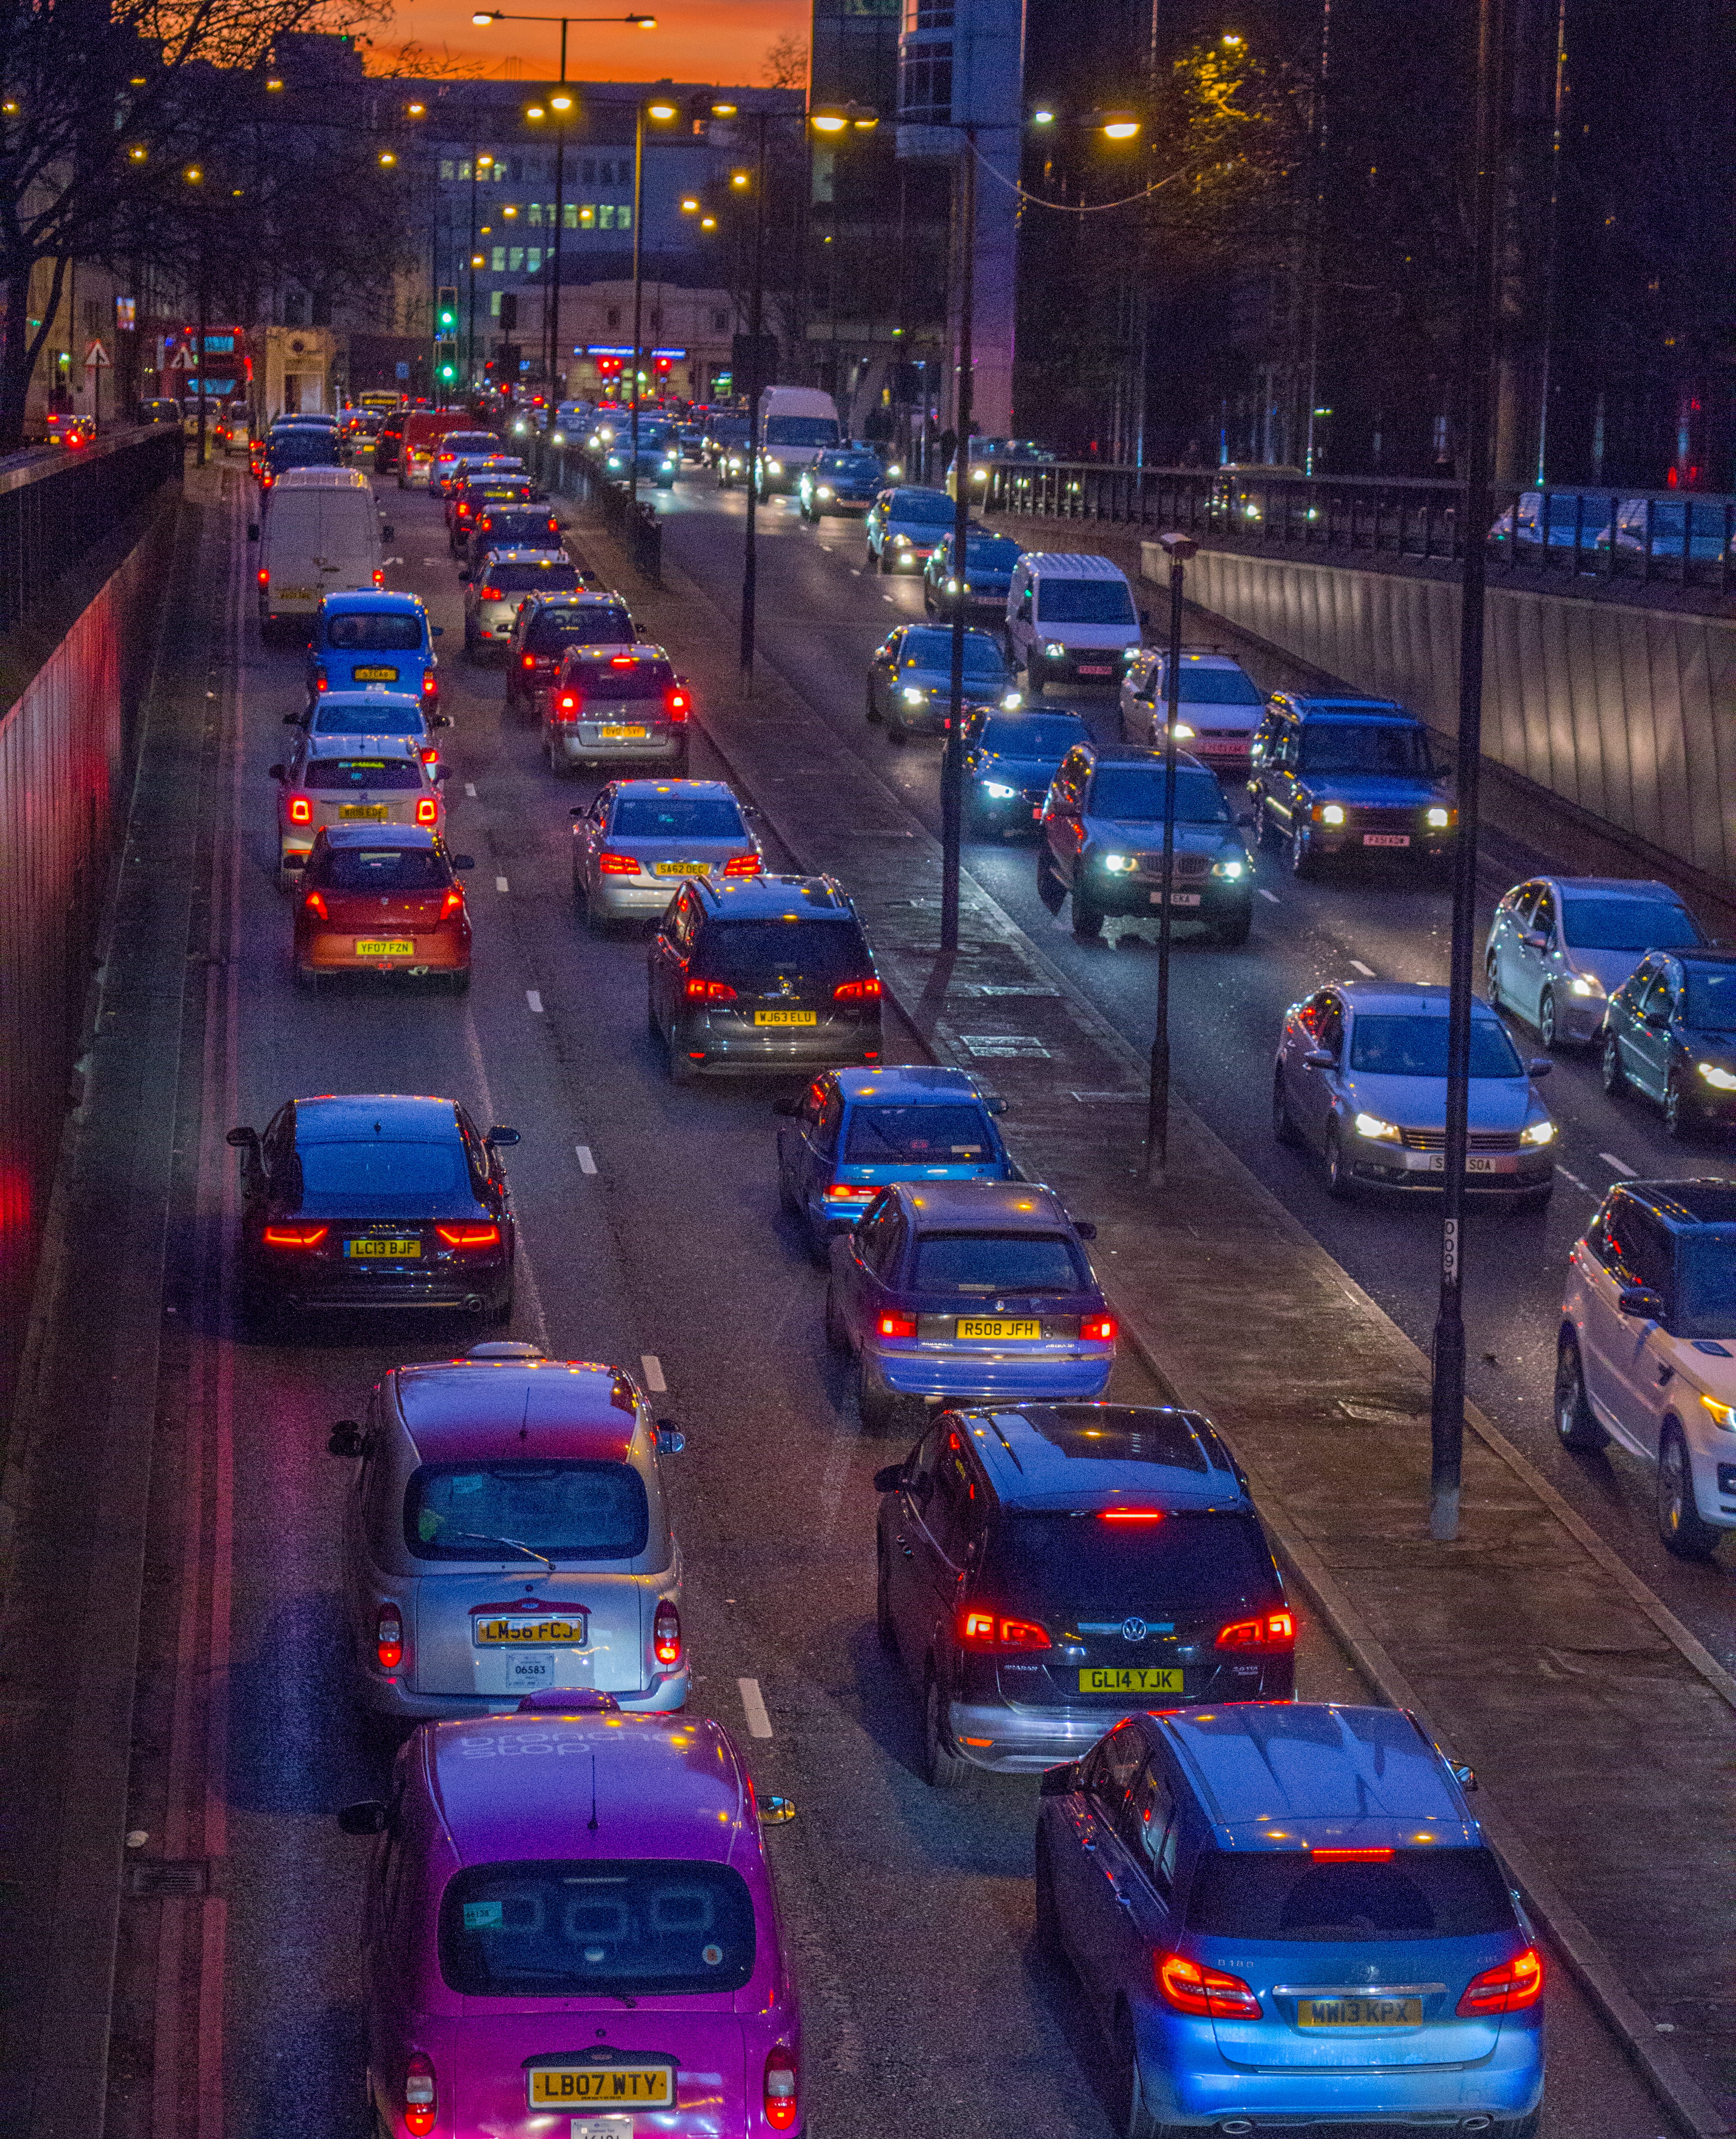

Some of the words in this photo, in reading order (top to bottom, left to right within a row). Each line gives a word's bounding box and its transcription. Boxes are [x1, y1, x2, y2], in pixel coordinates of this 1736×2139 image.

[661, 865, 684, 874] SA62
[361, 943, 386, 952] YF07
[389, 943, 408, 952] FZN
[760, 1012, 787, 1022] WJ63
[791, 1012, 811, 1022] ELU
[356, 1242, 386, 1254] LC13
[390, 1242, 415, 1254] BJF
[964, 1323, 1002, 1336] R508
[1006, 1323, 1034, 1336] JFH
[486, 1622, 533, 1639] LM56
[538, 1622, 573, 1639] FCJ
[515, 1665, 546, 1674] 06583
[1092, 1671, 1131, 1688] GL14
[1138, 1671, 1172, 1688] YJK
[1366, 2002, 1407, 2022] KPX
[545, 2074, 605, 2096] LB07
[613, 2073, 657, 2095] WTY
